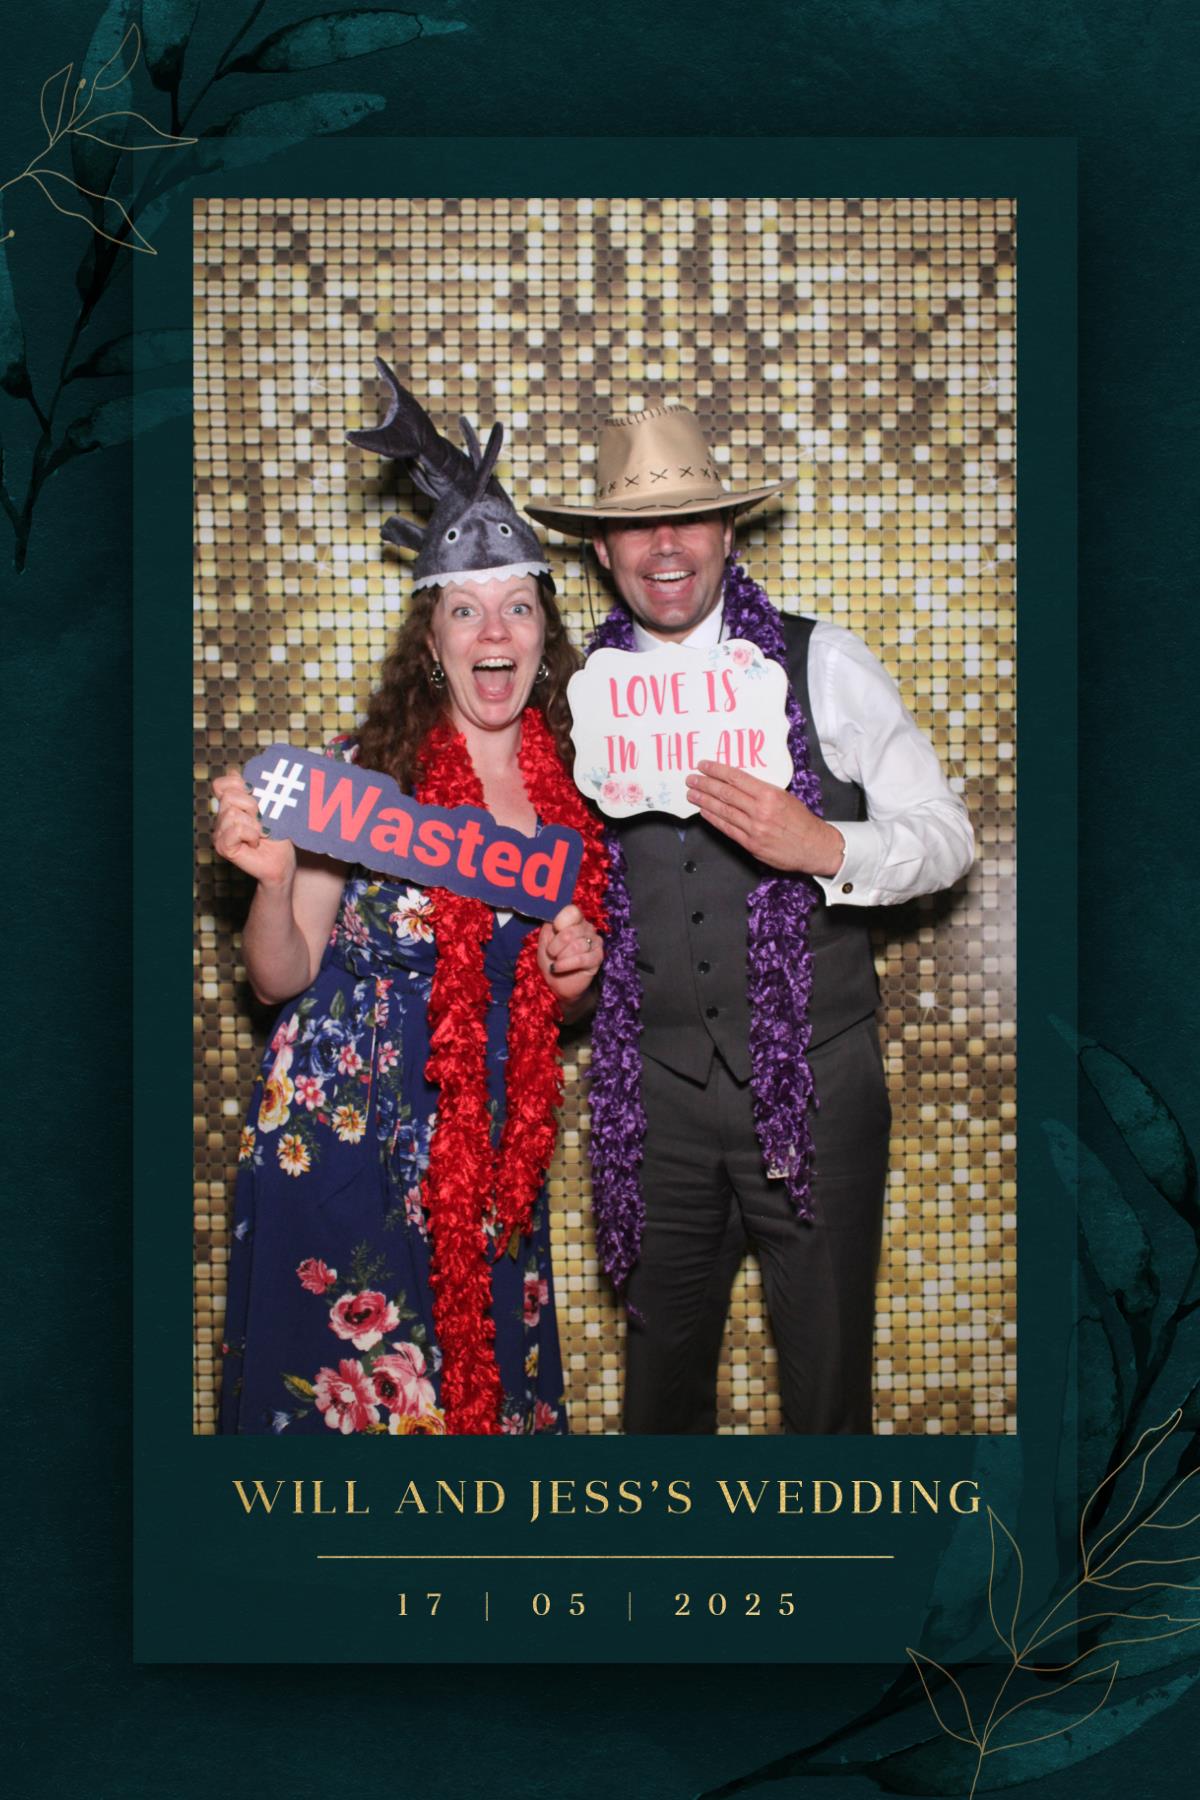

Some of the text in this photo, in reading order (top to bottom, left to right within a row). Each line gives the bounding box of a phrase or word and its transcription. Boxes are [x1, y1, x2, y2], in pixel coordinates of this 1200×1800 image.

[609, 668, 738, 718] LOVE IS
[651, 730, 701, 772] THE
[716, 728, 768, 769] AIR
[252, 758, 570, 902] #Wasted
